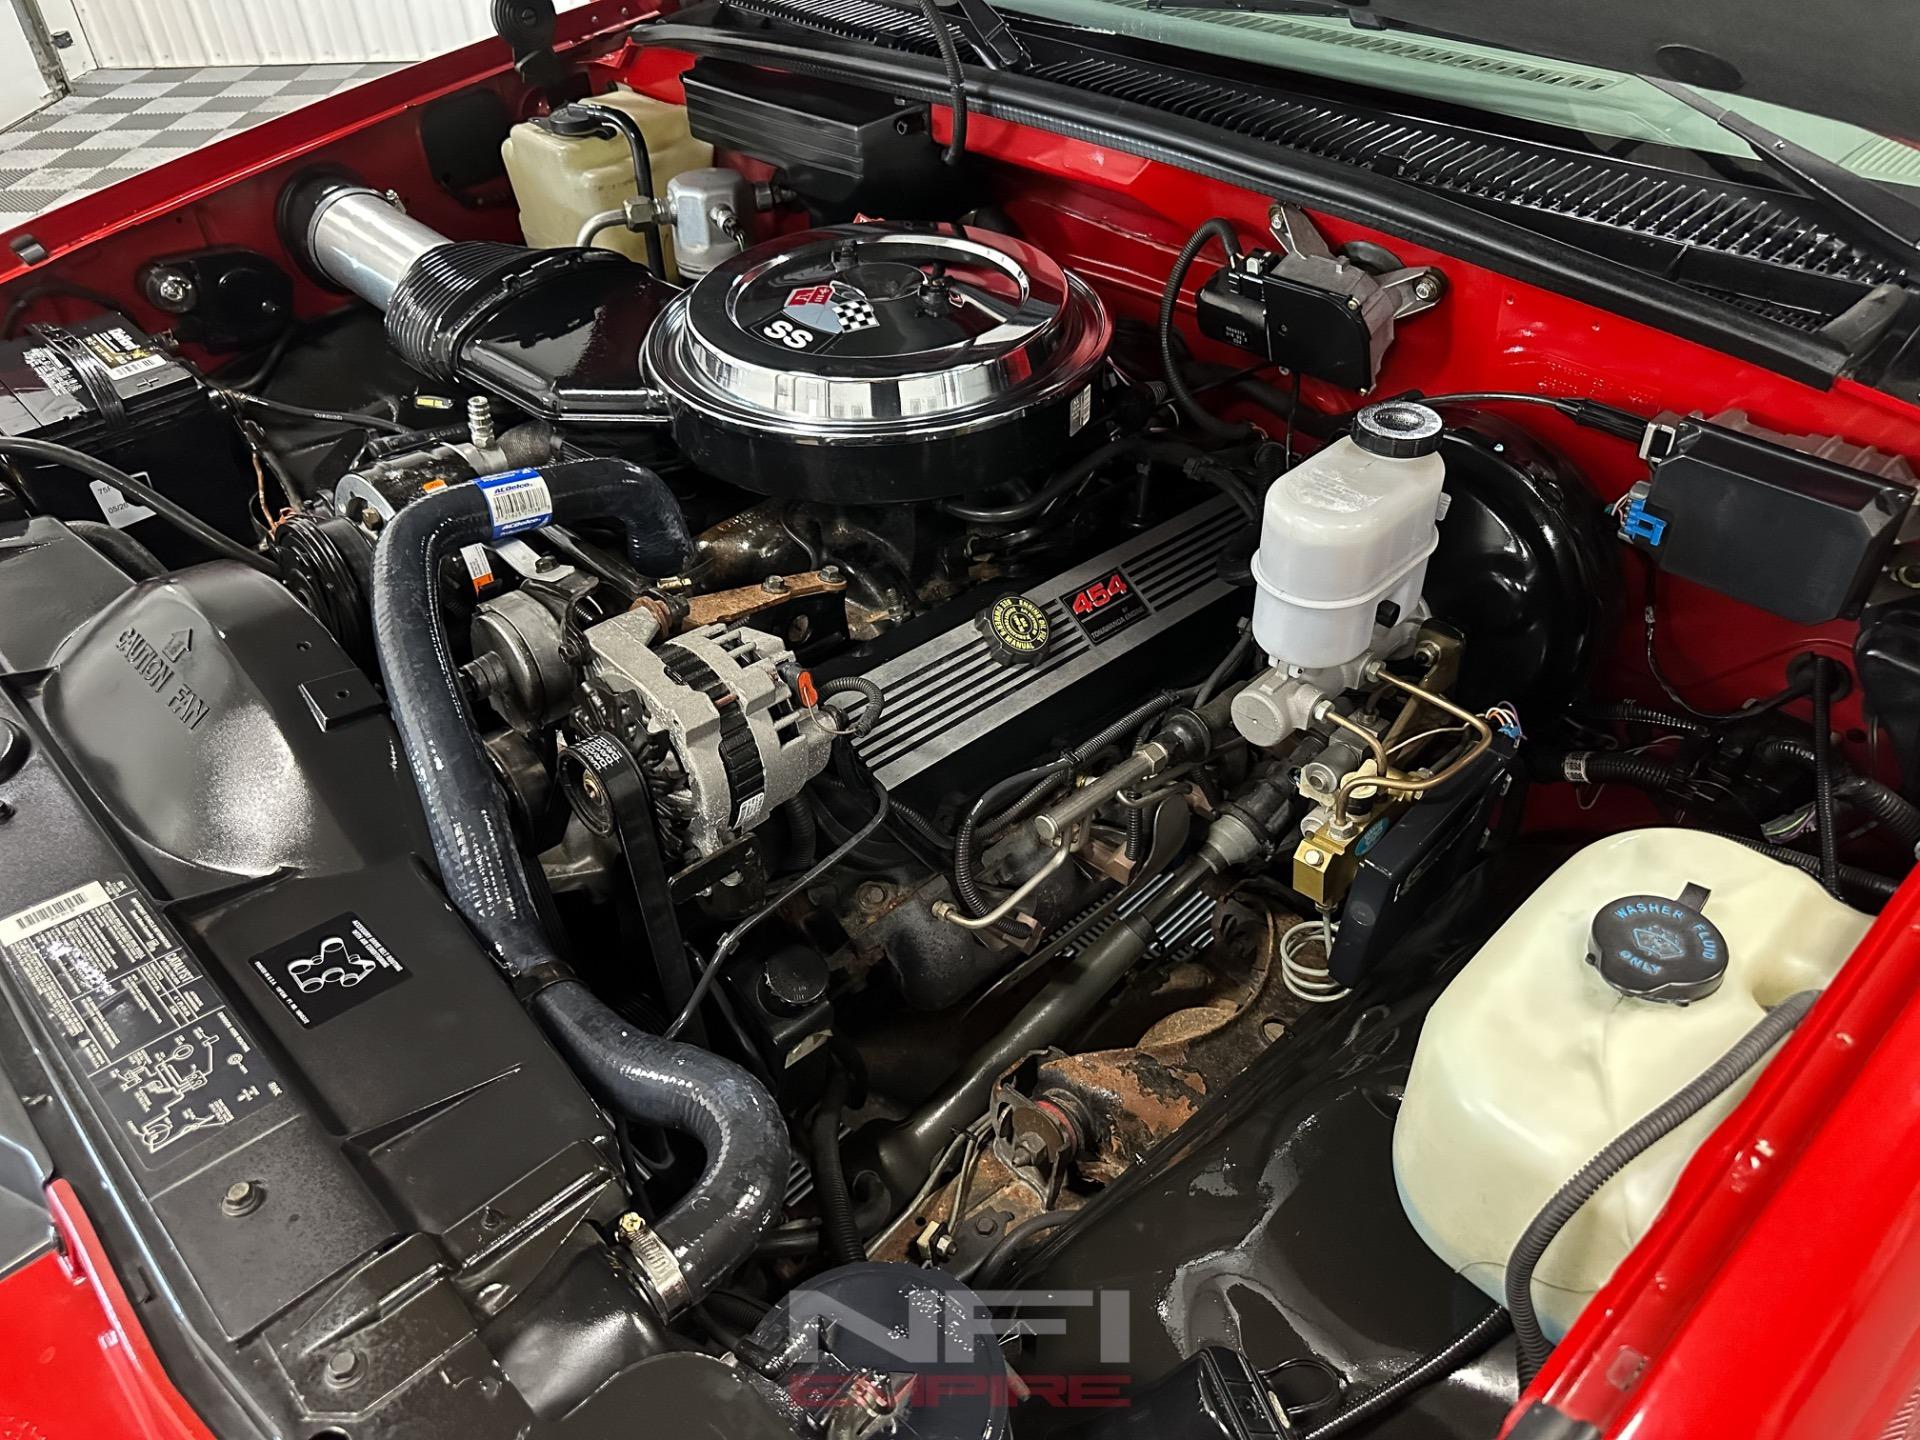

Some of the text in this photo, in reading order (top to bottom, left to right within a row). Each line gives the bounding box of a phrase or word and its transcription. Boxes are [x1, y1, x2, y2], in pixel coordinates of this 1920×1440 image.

[763, 319, 814, 349] SS
[1072, 574, 1128, 615] 454
[116, 627, 211, 731] CAUTION FAN
[1614, 902, 1717, 961] WASHER FLUID
[165, 952, 195, 983] CATALYST
[1618, 949, 1663, 975] ONLY
